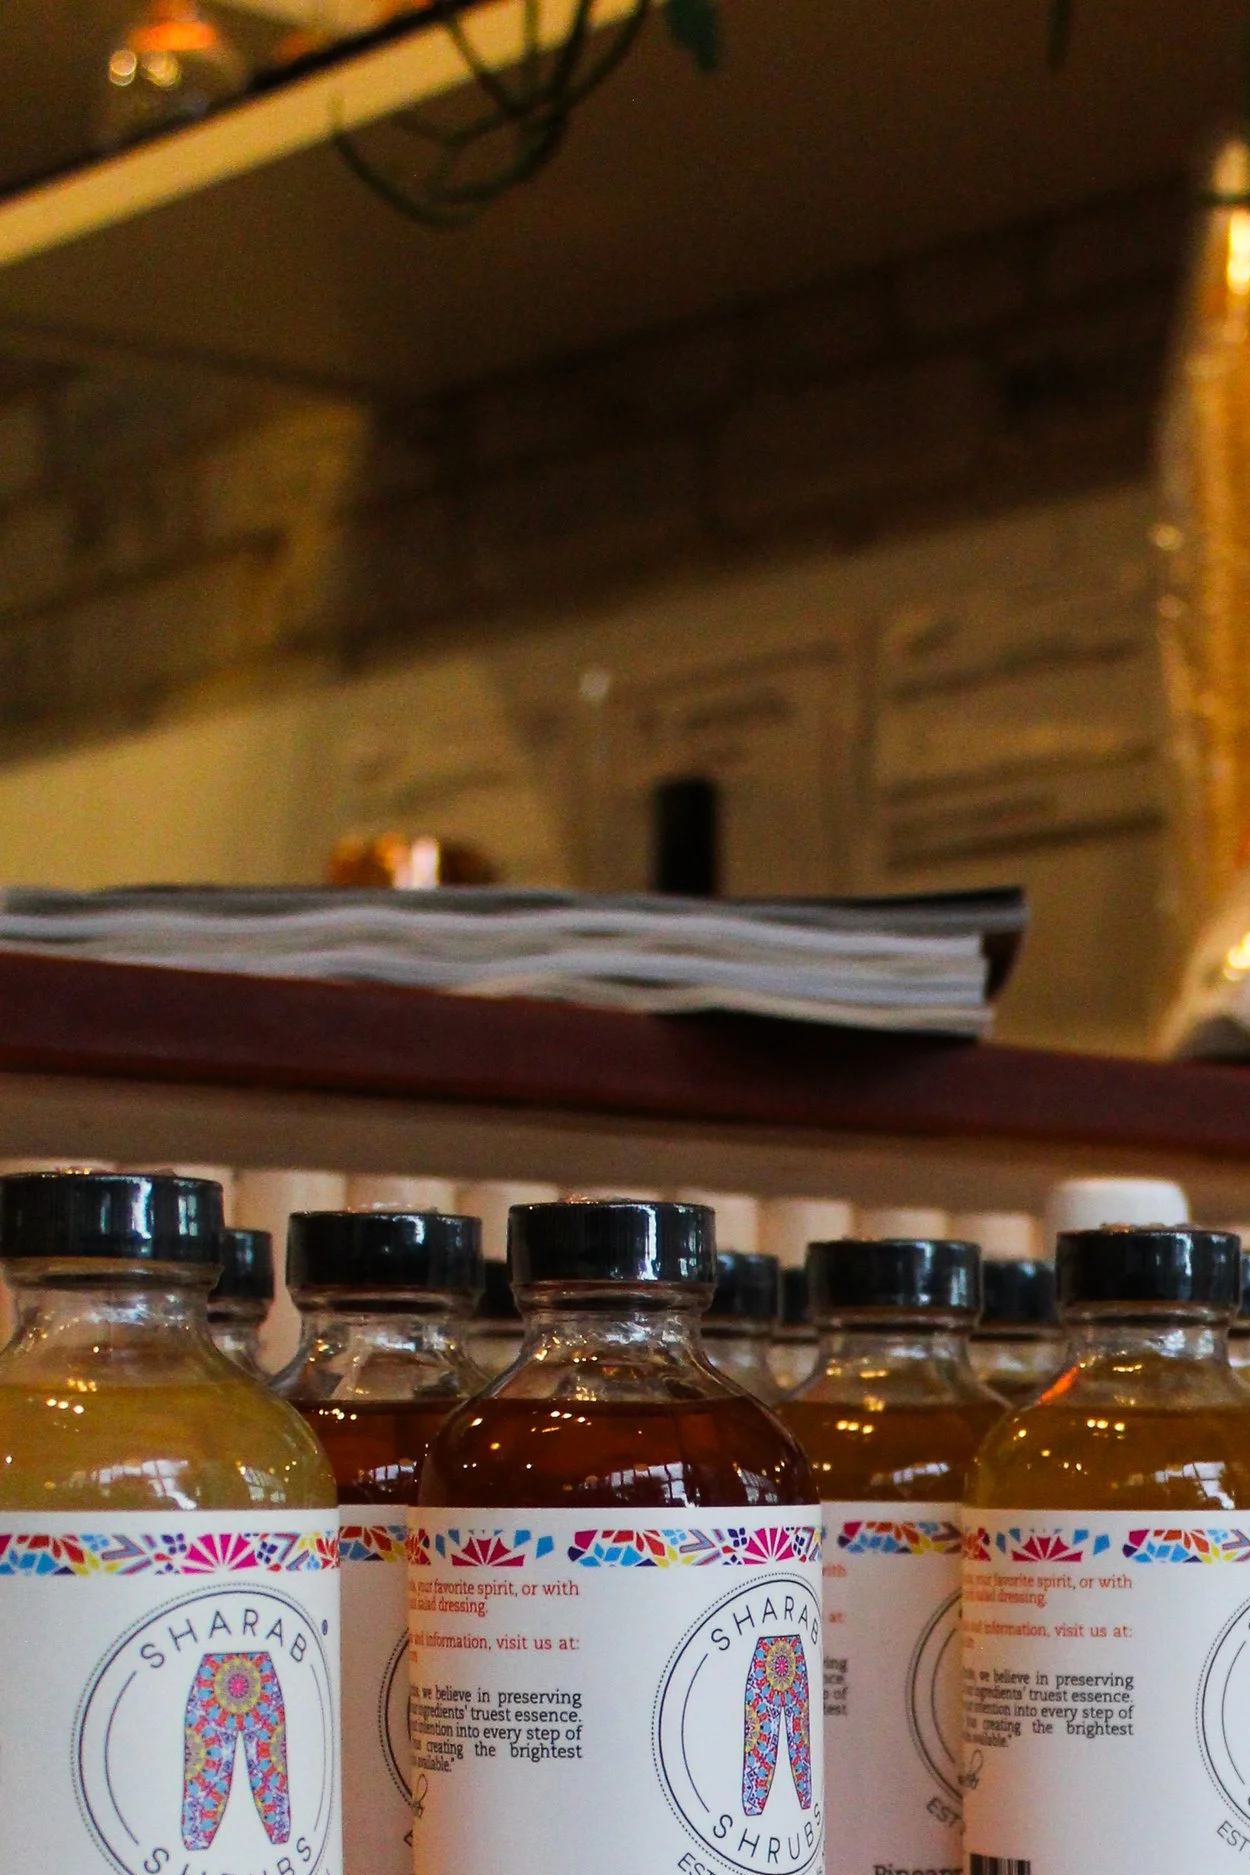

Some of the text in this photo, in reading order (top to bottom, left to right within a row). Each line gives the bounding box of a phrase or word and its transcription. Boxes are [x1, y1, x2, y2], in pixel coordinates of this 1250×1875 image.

[434, 1579, 579, 1599] favorite spirit, or with
[1037, 1575, 1076, 1591] spirit,
[1079, 1578, 1094, 1588] or
[1099, 1574, 1132, 1588] with
[710, 1596, 819, 1651] SHARAB
[1055, 1625, 1084, 1638] visit
[1090, 1627, 1107, 1638] us
[1113, 1626, 1132, 1638] at:
[140, 1608, 308, 1669] SHARAB
[496, 1633, 527, 1650] visit
[534, 1638, 552, 1650] us
[559, 1636, 579, 1650] at:
[1036, 1671, 1048, 1685] in
[1055, 1672, 1134, 1689] preserving
[435, 1685, 582, 1709] believe in preserving
[1029, 1688, 1133, 1702] truest essence.
[471, 1707, 582, 1723] truest essence.
[1014, 1704, 1134, 1723] into every step of
[456, 1722, 480, 1738] into
[483, 1727, 522, 1744] every
[526, 1728, 560, 1744] step
[565, 1725, 583, 1740] of
[1032, 1720, 1053, 1734] the
[1066, 1722, 1134, 1738] brightest
[427, 1739, 582, 1762] creating the brightest
[713, 1803, 821, 1864] SHRUBS
[1217, 1820, 1250, 1852] EST
